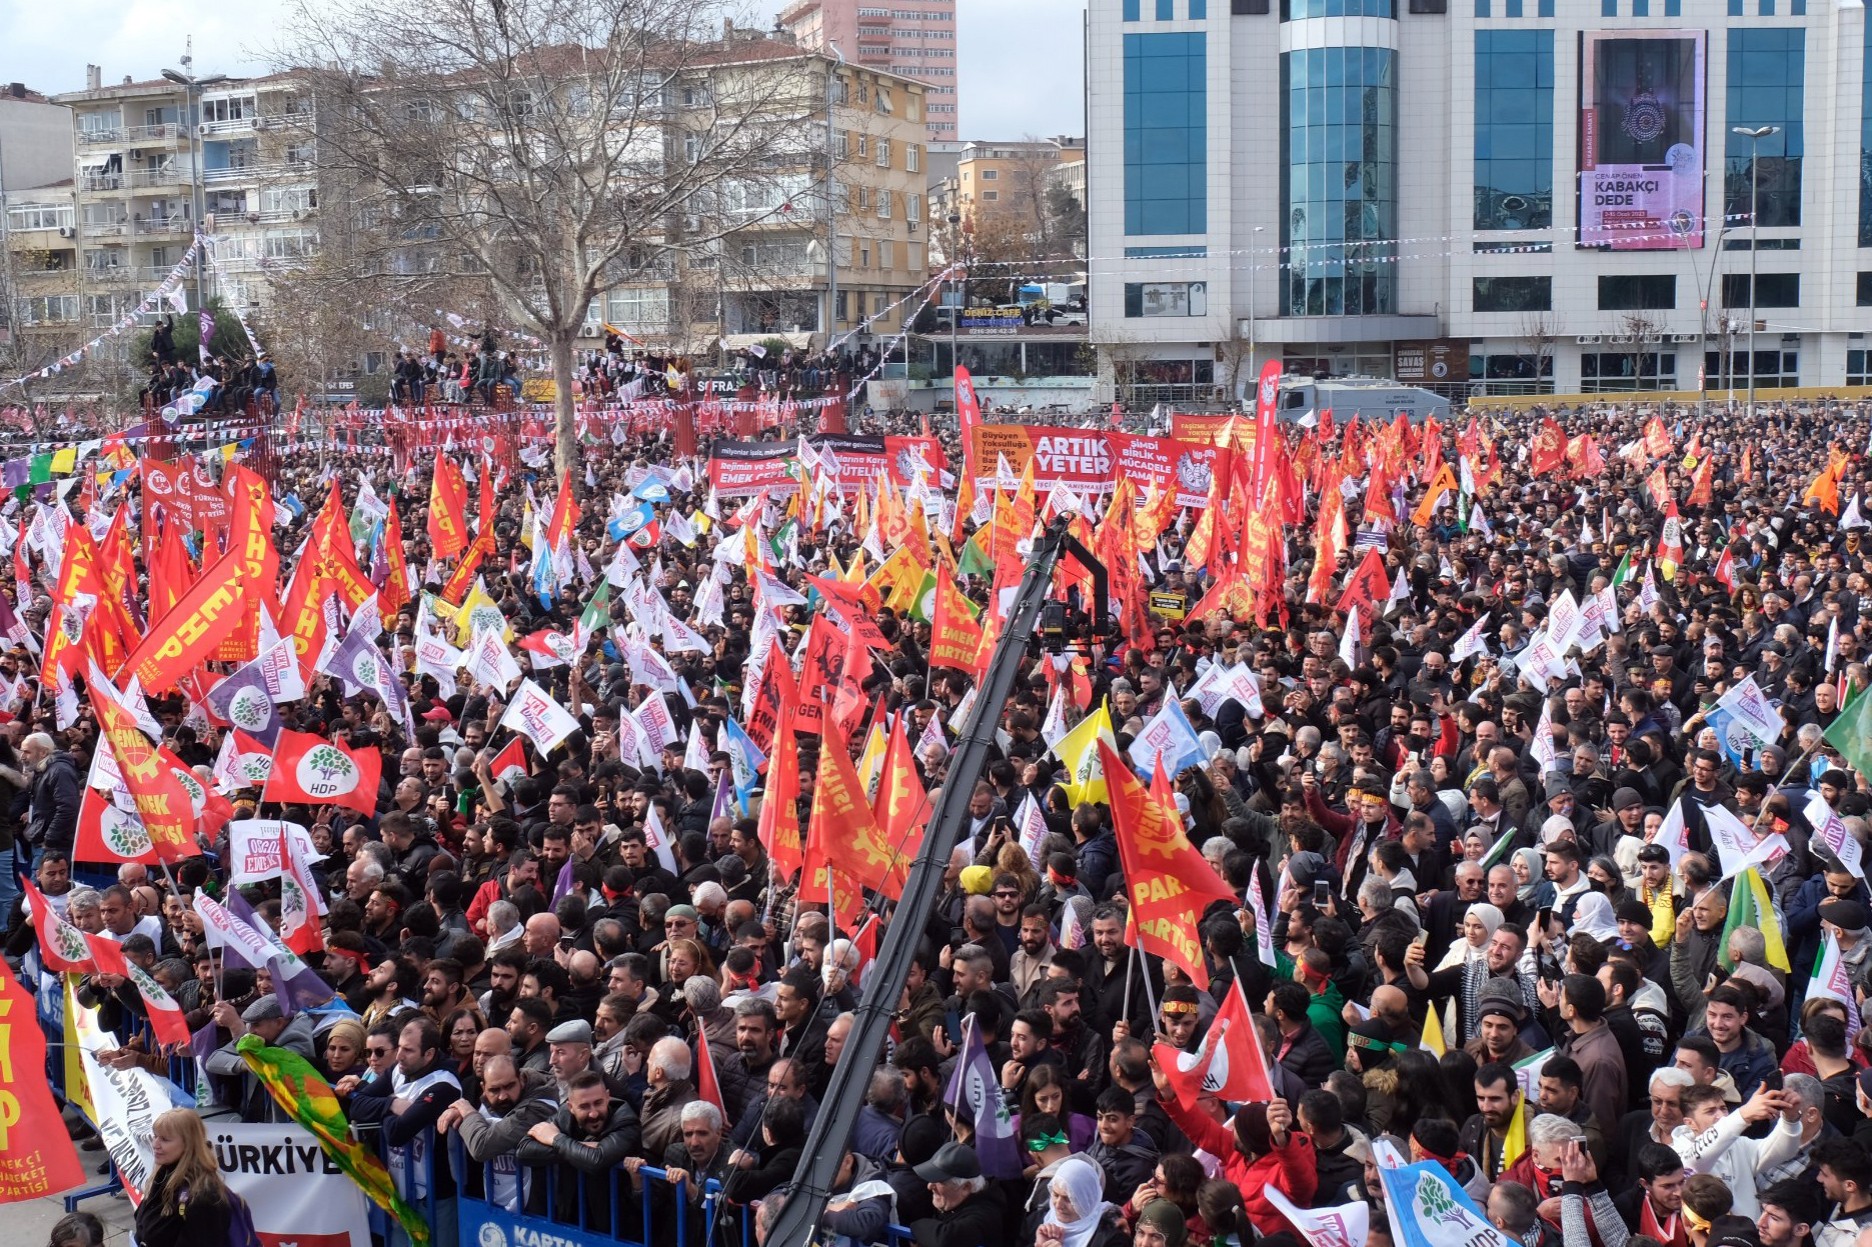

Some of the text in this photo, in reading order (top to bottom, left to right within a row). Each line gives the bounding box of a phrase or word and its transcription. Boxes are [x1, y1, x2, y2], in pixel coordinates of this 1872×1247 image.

[1594, 180, 1659, 194] KABAKÇI
[1594, 194, 1634, 206] DEDE
[982, 431, 1019, 441] Büyüyen
[982, 440, 1028, 449] Yoksulluğa
[1035, 436, 1109, 457] ARTIK
[1130, 438, 1159, 451] ŞİMDİ
[1122, 447, 1169, 463] BİRLİK ve
[1035, 453, 1111, 475] YETER
[1119, 457, 1172, 475] MÜCADELE
[719, 473, 753, 484] EMEK
[941, 625, 977, 647] EMEK
[115, 729, 149, 748] EME
[309, 783, 338, 795] HDP
[207, 1134, 343, 1175] ÜRKİYE
